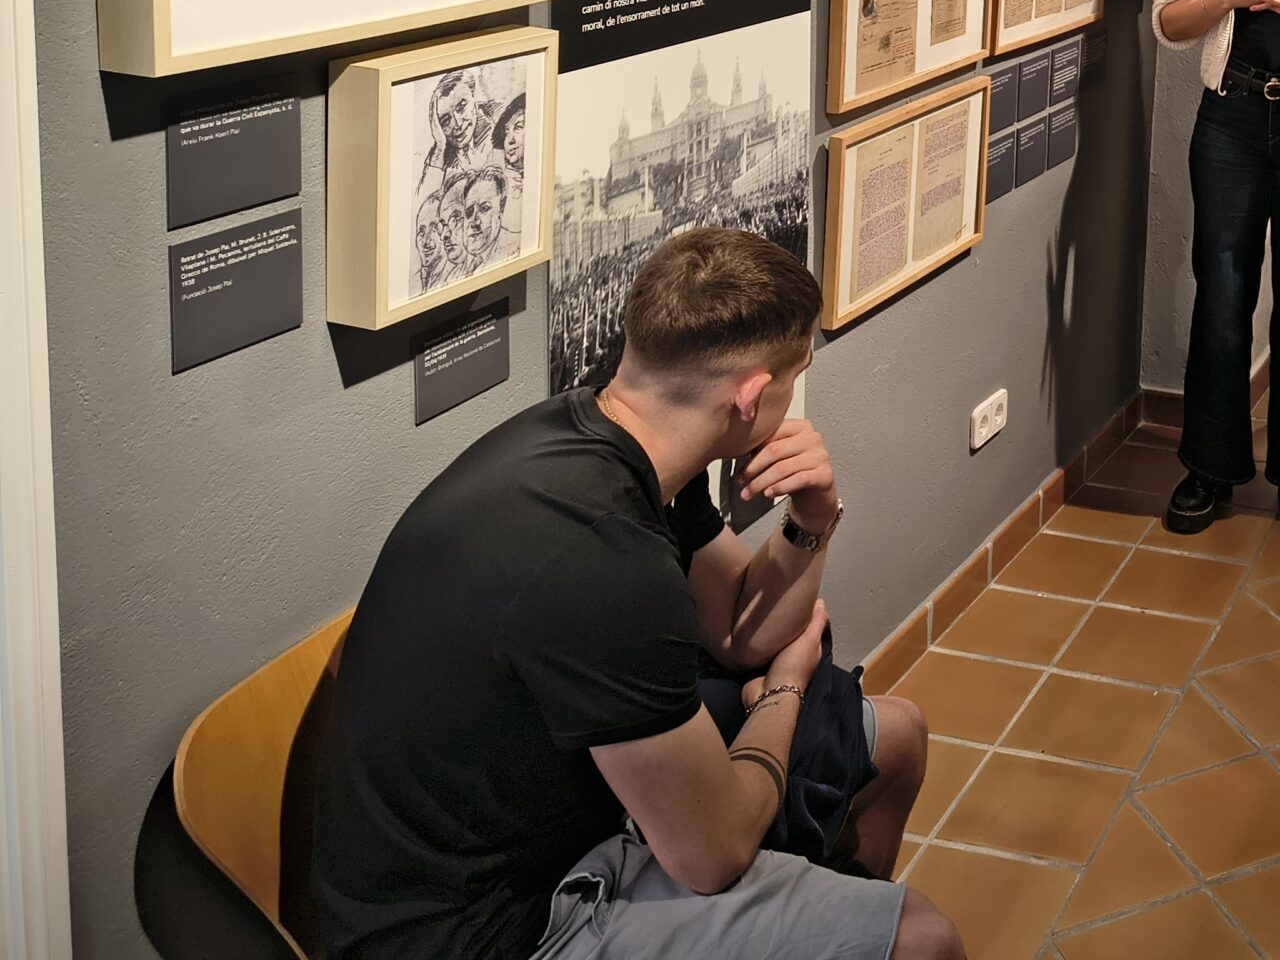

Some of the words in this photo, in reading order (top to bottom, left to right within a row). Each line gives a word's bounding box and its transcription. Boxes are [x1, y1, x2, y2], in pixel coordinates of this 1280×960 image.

[582, 1, 604, 14] camin
[605, 0, 612, 9] di
[582, 18, 605, 32] moral,
[606, 17, 616, 27] de
[617, 7, 661, 24] l'ensorrament
[662, 4, 670, 14] de
[671, 2, 680, 12] tot
[681, 2, 689, 10] un
[223, 116, 241, 124] Guerra
[205, 248, 220, 256] Josep
[207, 284, 223, 293] Josep
